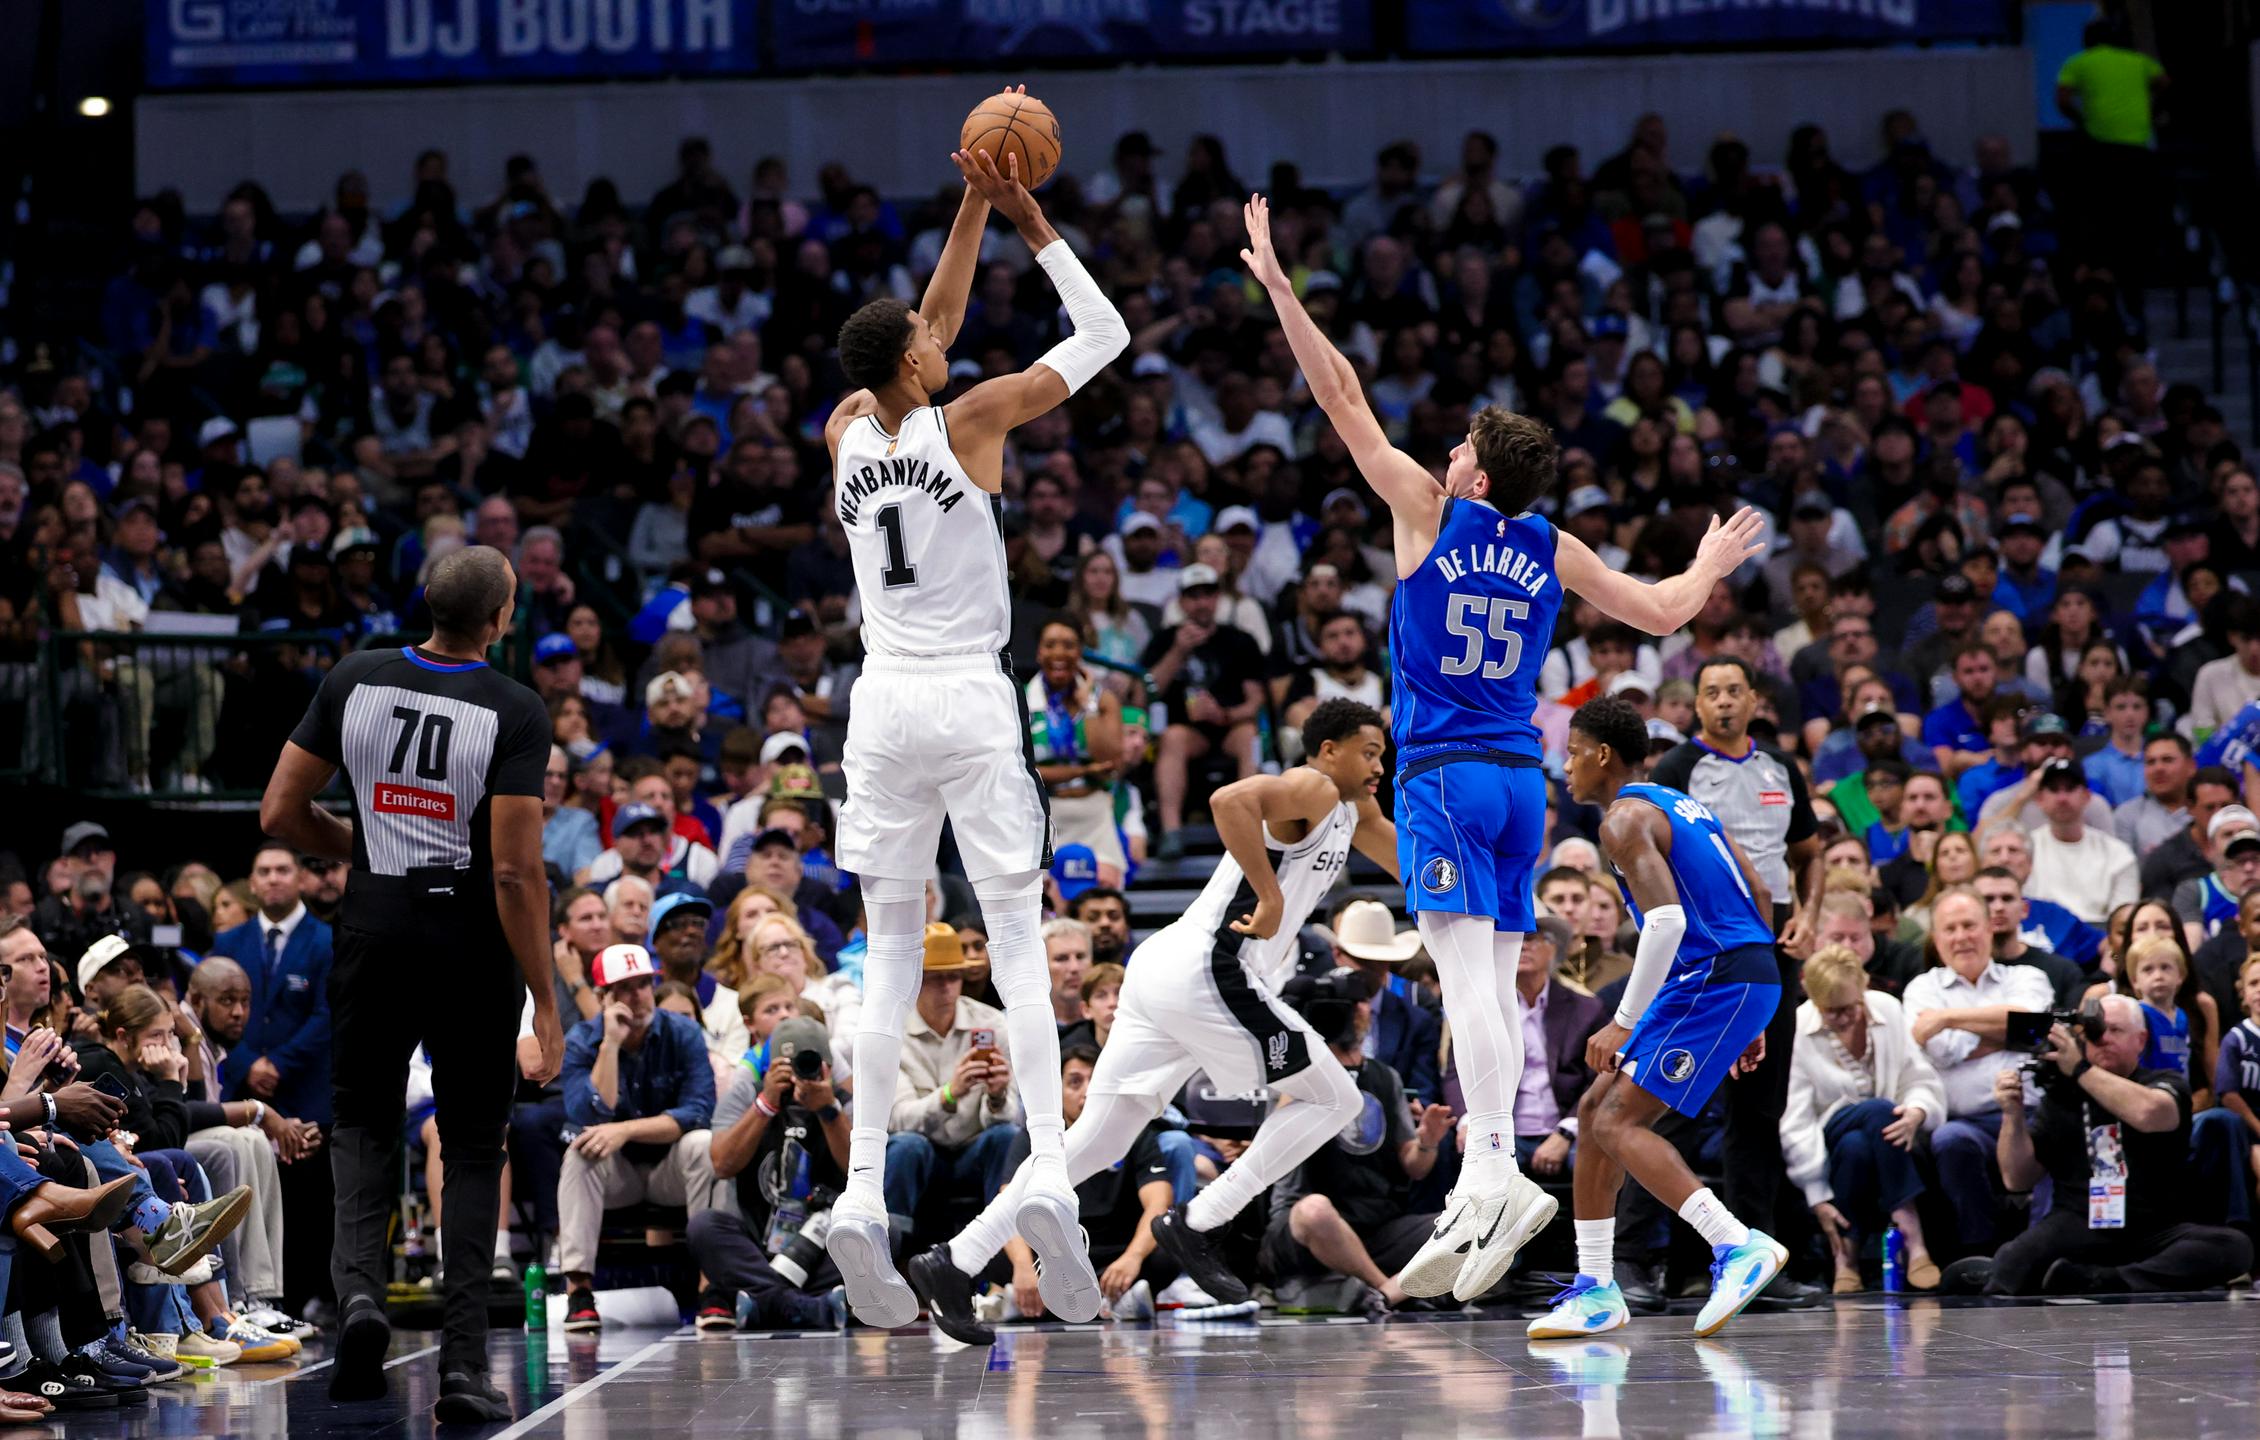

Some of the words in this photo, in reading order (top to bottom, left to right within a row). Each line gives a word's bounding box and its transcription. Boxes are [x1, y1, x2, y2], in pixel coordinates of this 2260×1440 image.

[1183, 0, 1343, 36] STAGE
[840, 457, 965, 527] WEMBANYAMA
[874, 501, 920, 591] 1
[1434, 548, 1467, 584] DE
[1471, 543, 1549, 598] LARREA
[1440, 592, 1530, 680] 55
[388, 705, 455, 781] 70
[381, 790, 448, 814] Emirates
